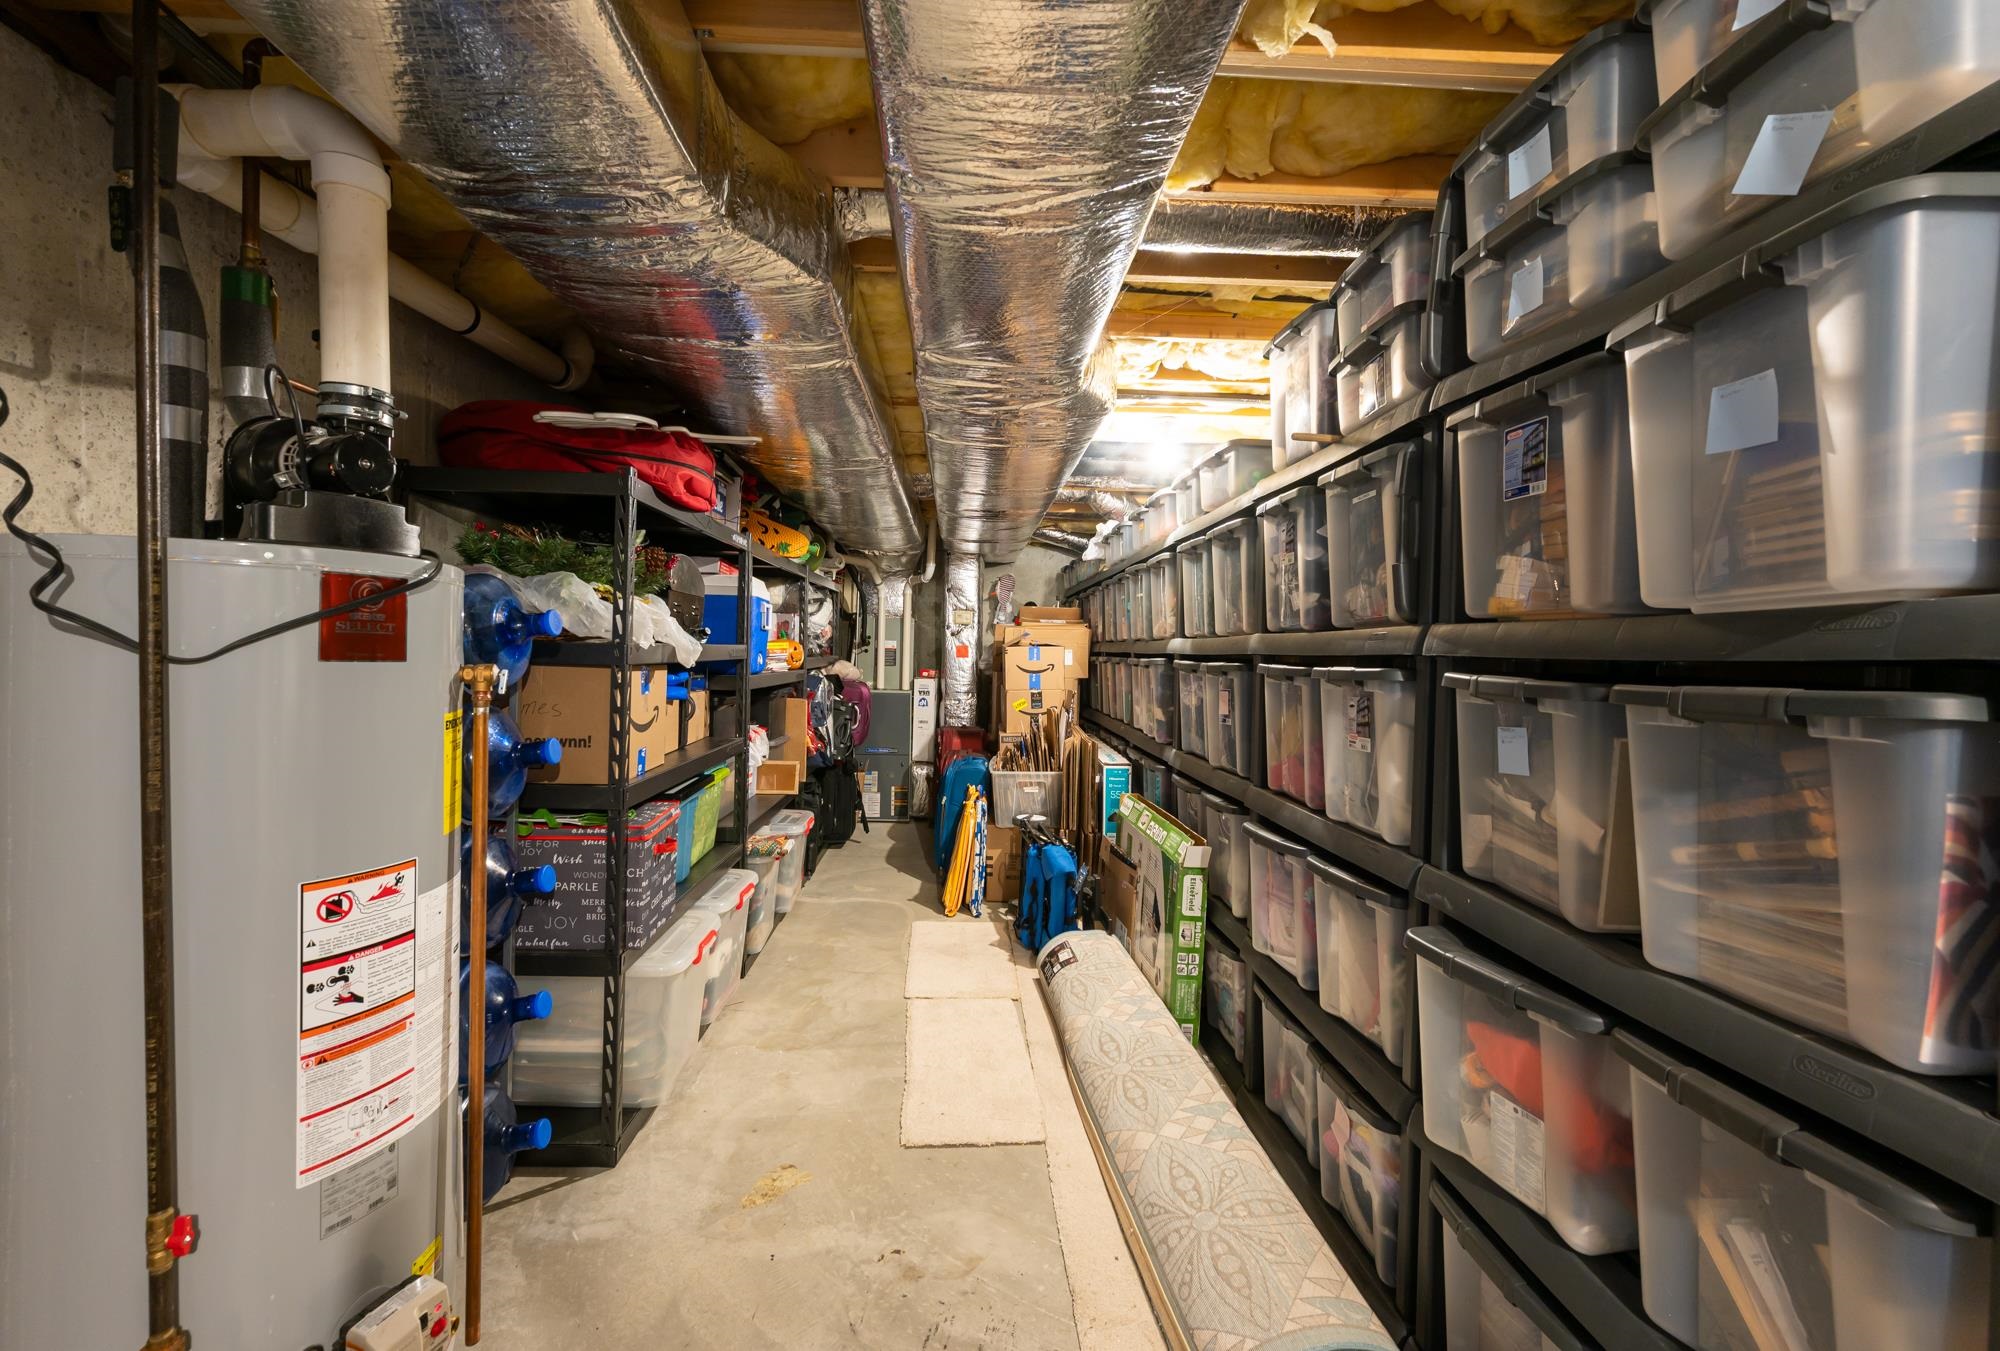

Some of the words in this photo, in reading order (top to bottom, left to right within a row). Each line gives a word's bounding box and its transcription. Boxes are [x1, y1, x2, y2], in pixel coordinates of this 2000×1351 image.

[335, 620, 396, 631] SELECT
[552, 854, 584, 864] Wish
[354, 870, 385, 882] WARNING
[555, 882, 599, 892] PARKLE
[1188, 878, 1197, 912] EliteField
[545, 916, 578, 929] JOY
[550, 938, 570, 950] fun
[354, 945, 384, 959] DANGER
[1799, 1057, 1866, 1098] Sterilite
